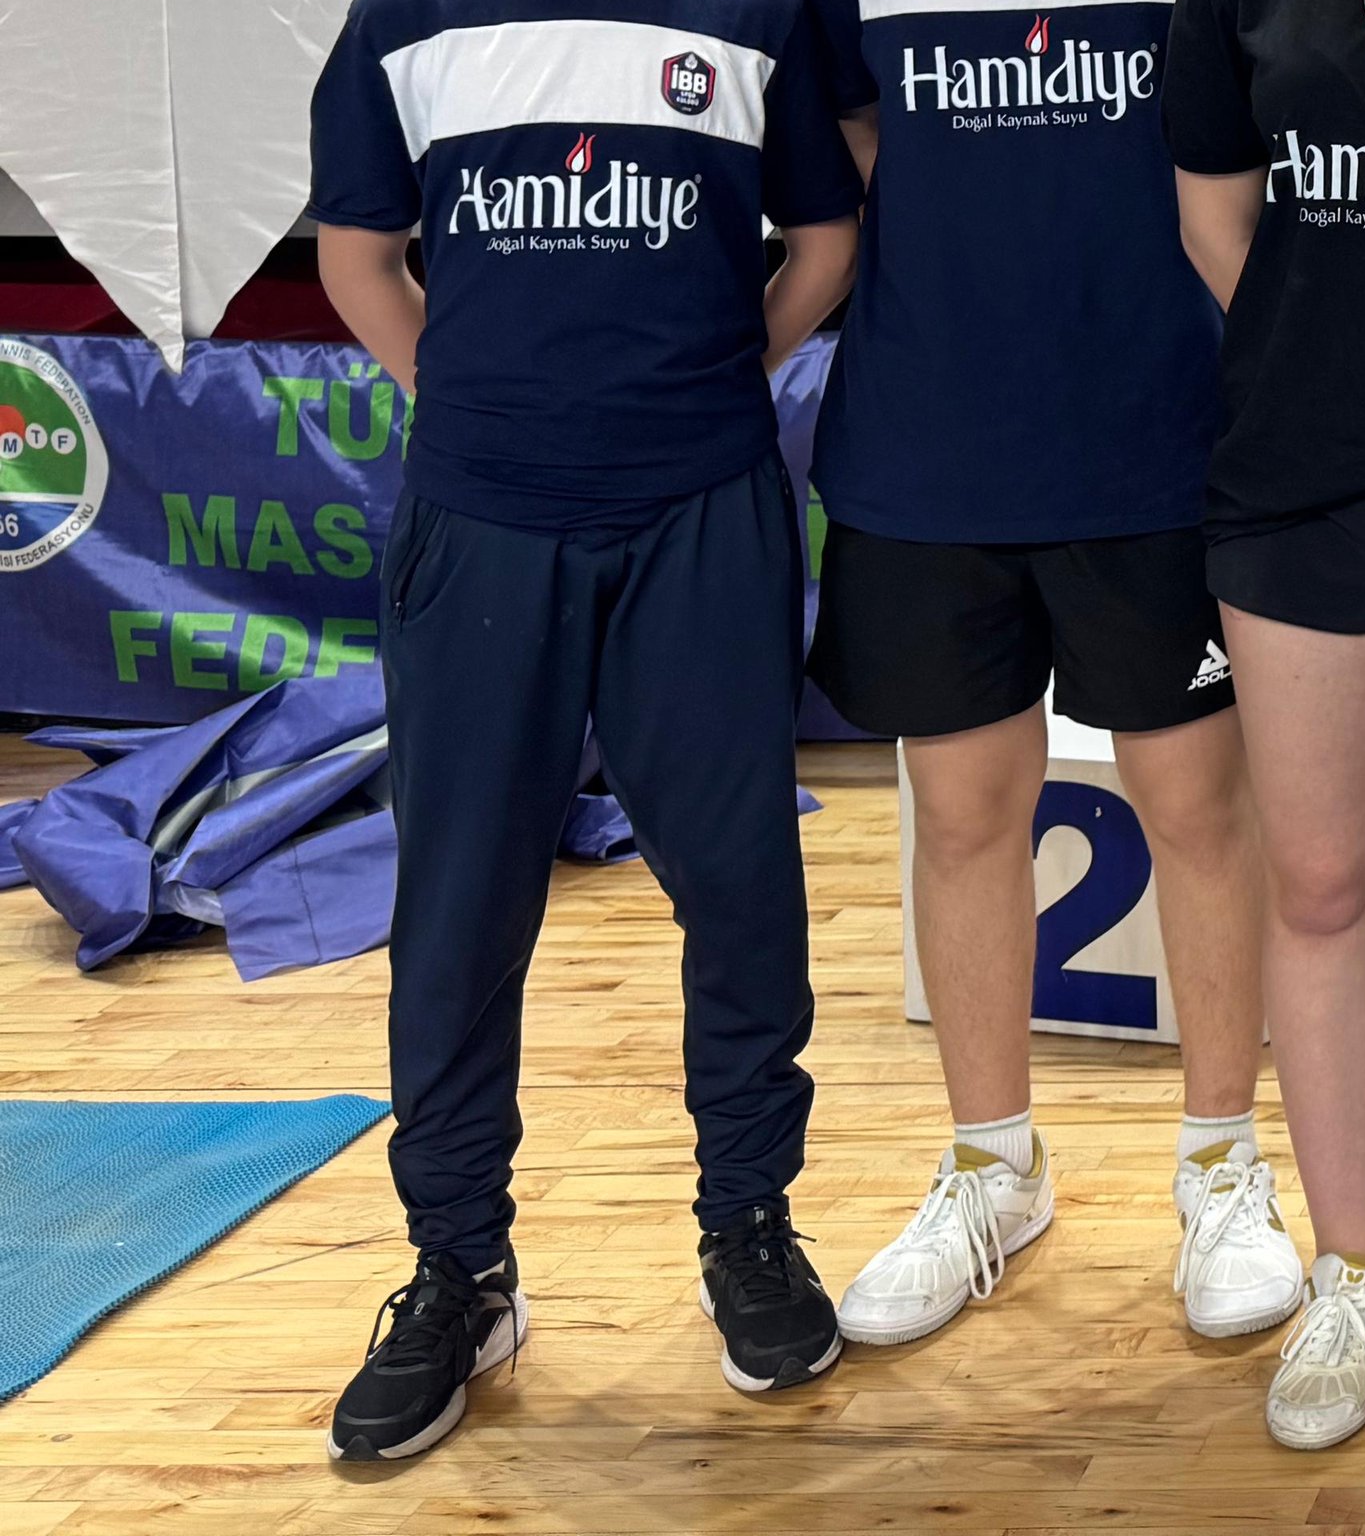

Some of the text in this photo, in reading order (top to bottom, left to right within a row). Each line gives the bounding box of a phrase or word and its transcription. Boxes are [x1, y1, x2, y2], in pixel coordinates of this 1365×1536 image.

[900, 39, 1154, 122] Hamidiye
[953, 110, 1088, 133] Doğal Kaynak Suyu
[448, 160, 700, 250] Hamidiye
[1299, 207, 1341, 227] Doğal
[487, 234, 630, 255] Doğal Kaynak Suyu
[1031, 780, 1158, 1030] 2
